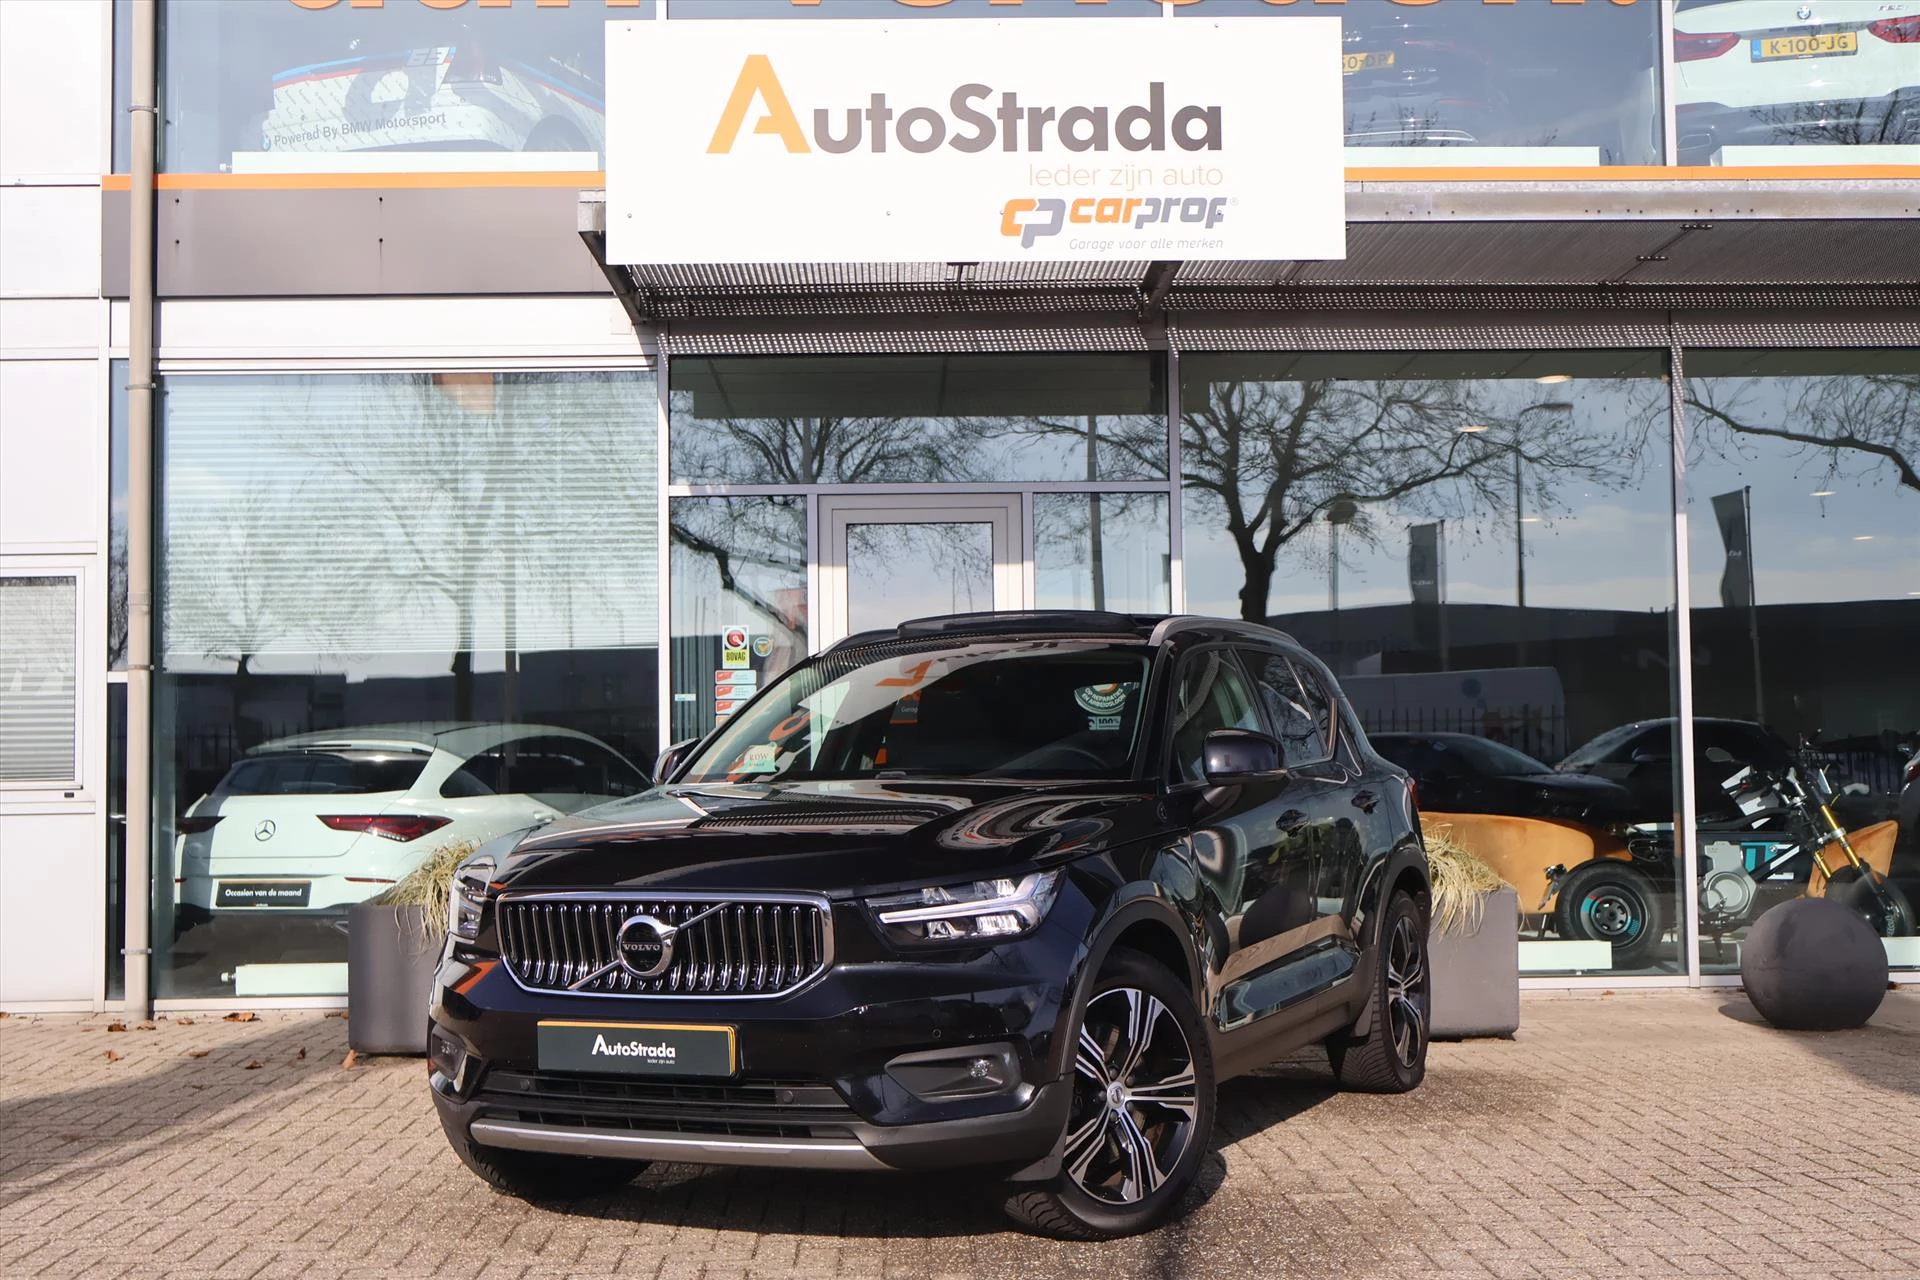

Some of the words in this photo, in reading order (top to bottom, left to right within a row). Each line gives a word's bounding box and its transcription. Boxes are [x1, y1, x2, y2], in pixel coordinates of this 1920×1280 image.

[1770, 36, 1849, 54] K-100-JG
[705, 54, 1222, 154] AutoStrada
[274, 126, 320, 146] Powered
[323, 126, 338, 139] By
[342, 119, 371, 135] BMW
[375, 112, 447, 130] Motorsport
[1029, 164, 1100, 186] Ieder
[1109, 164, 1153, 191] zijn
[1163, 166, 1224, 186] auto
[1069, 238, 1114, 251] Garage
[1119, 240, 1147, 249] voor
[1150, 238, 1173, 249] alle
[1177, 237, 1224, 249] merken
[726, 652, 746, 661] BOVAG
[225, 889, 254, 897] Occasion
[268, 888, 276, 896] de
[591, 1034, 676, 1058] AutoStrada
